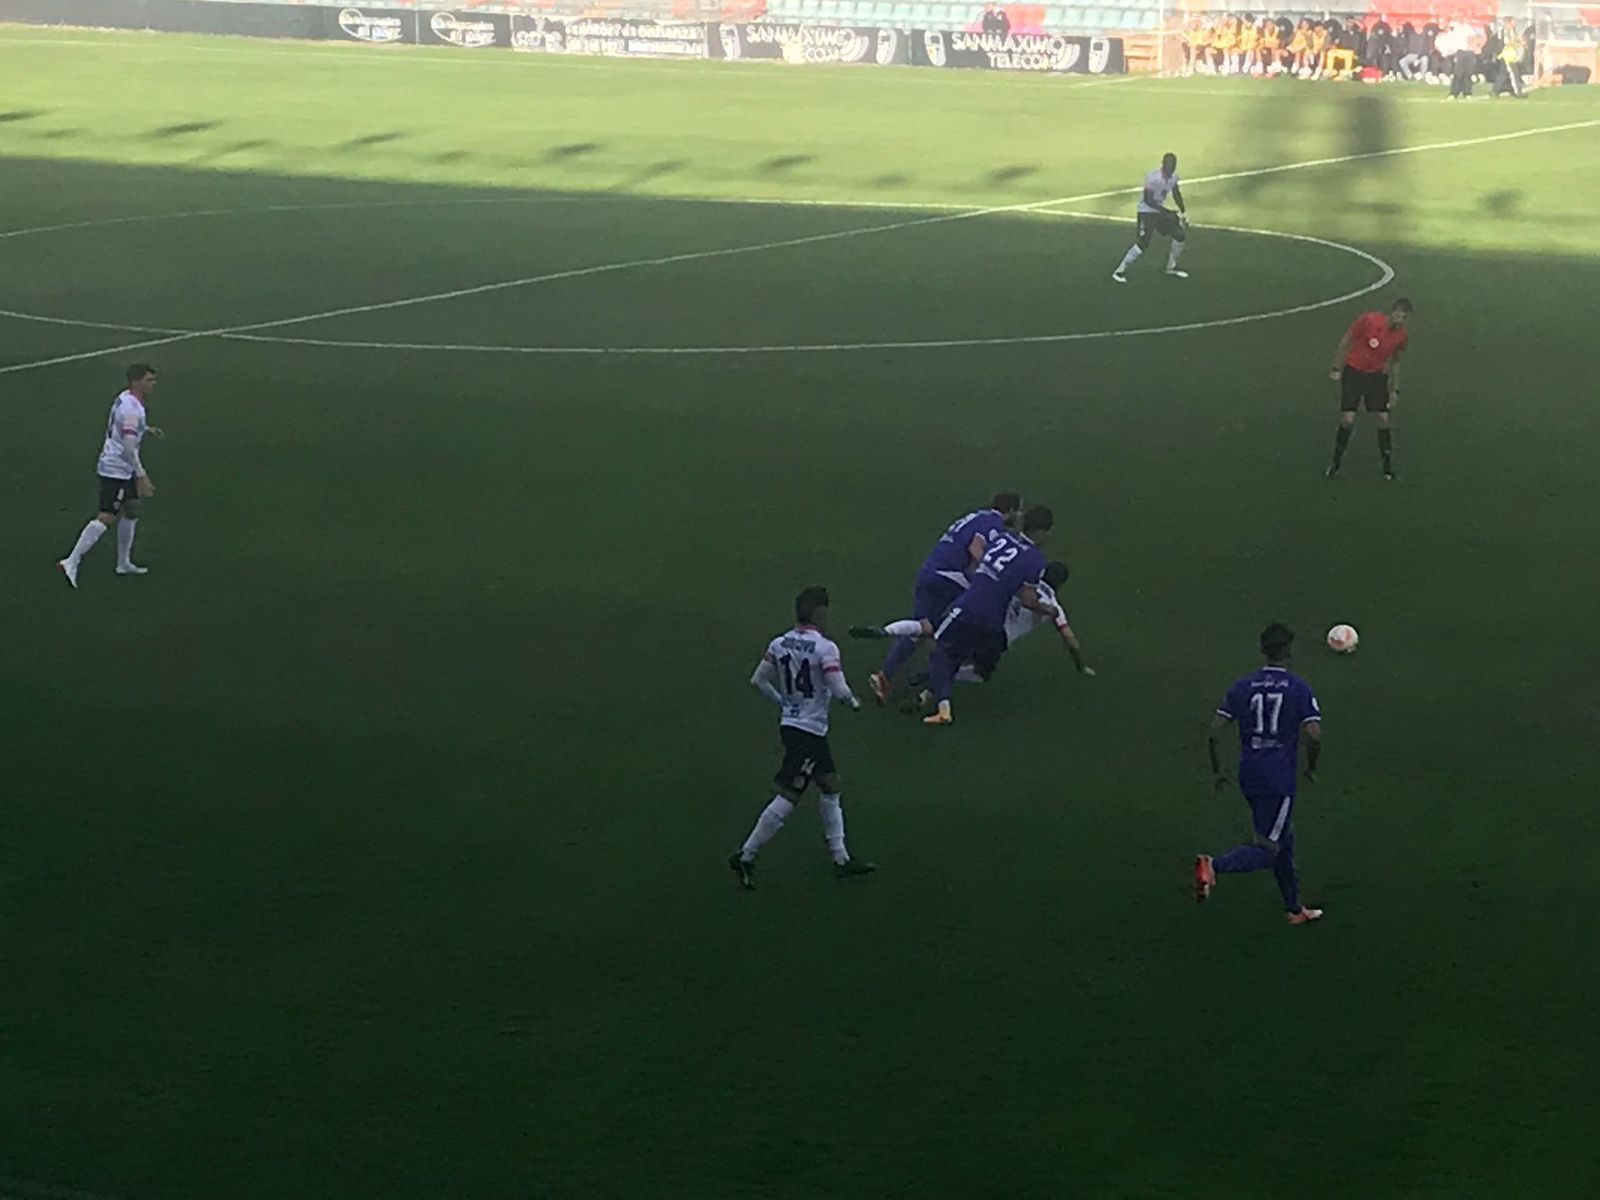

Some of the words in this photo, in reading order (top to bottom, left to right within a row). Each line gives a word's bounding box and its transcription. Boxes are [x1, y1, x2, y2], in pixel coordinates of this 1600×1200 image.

[952, 33, 1065, 54] SANMAXIMO
[987, 52, 1057, 69] TELECOM
[983, 538, 1018, 571] 22
[779, 652, 815, 698] 14
[1251, 693, 1284, 734] 17
